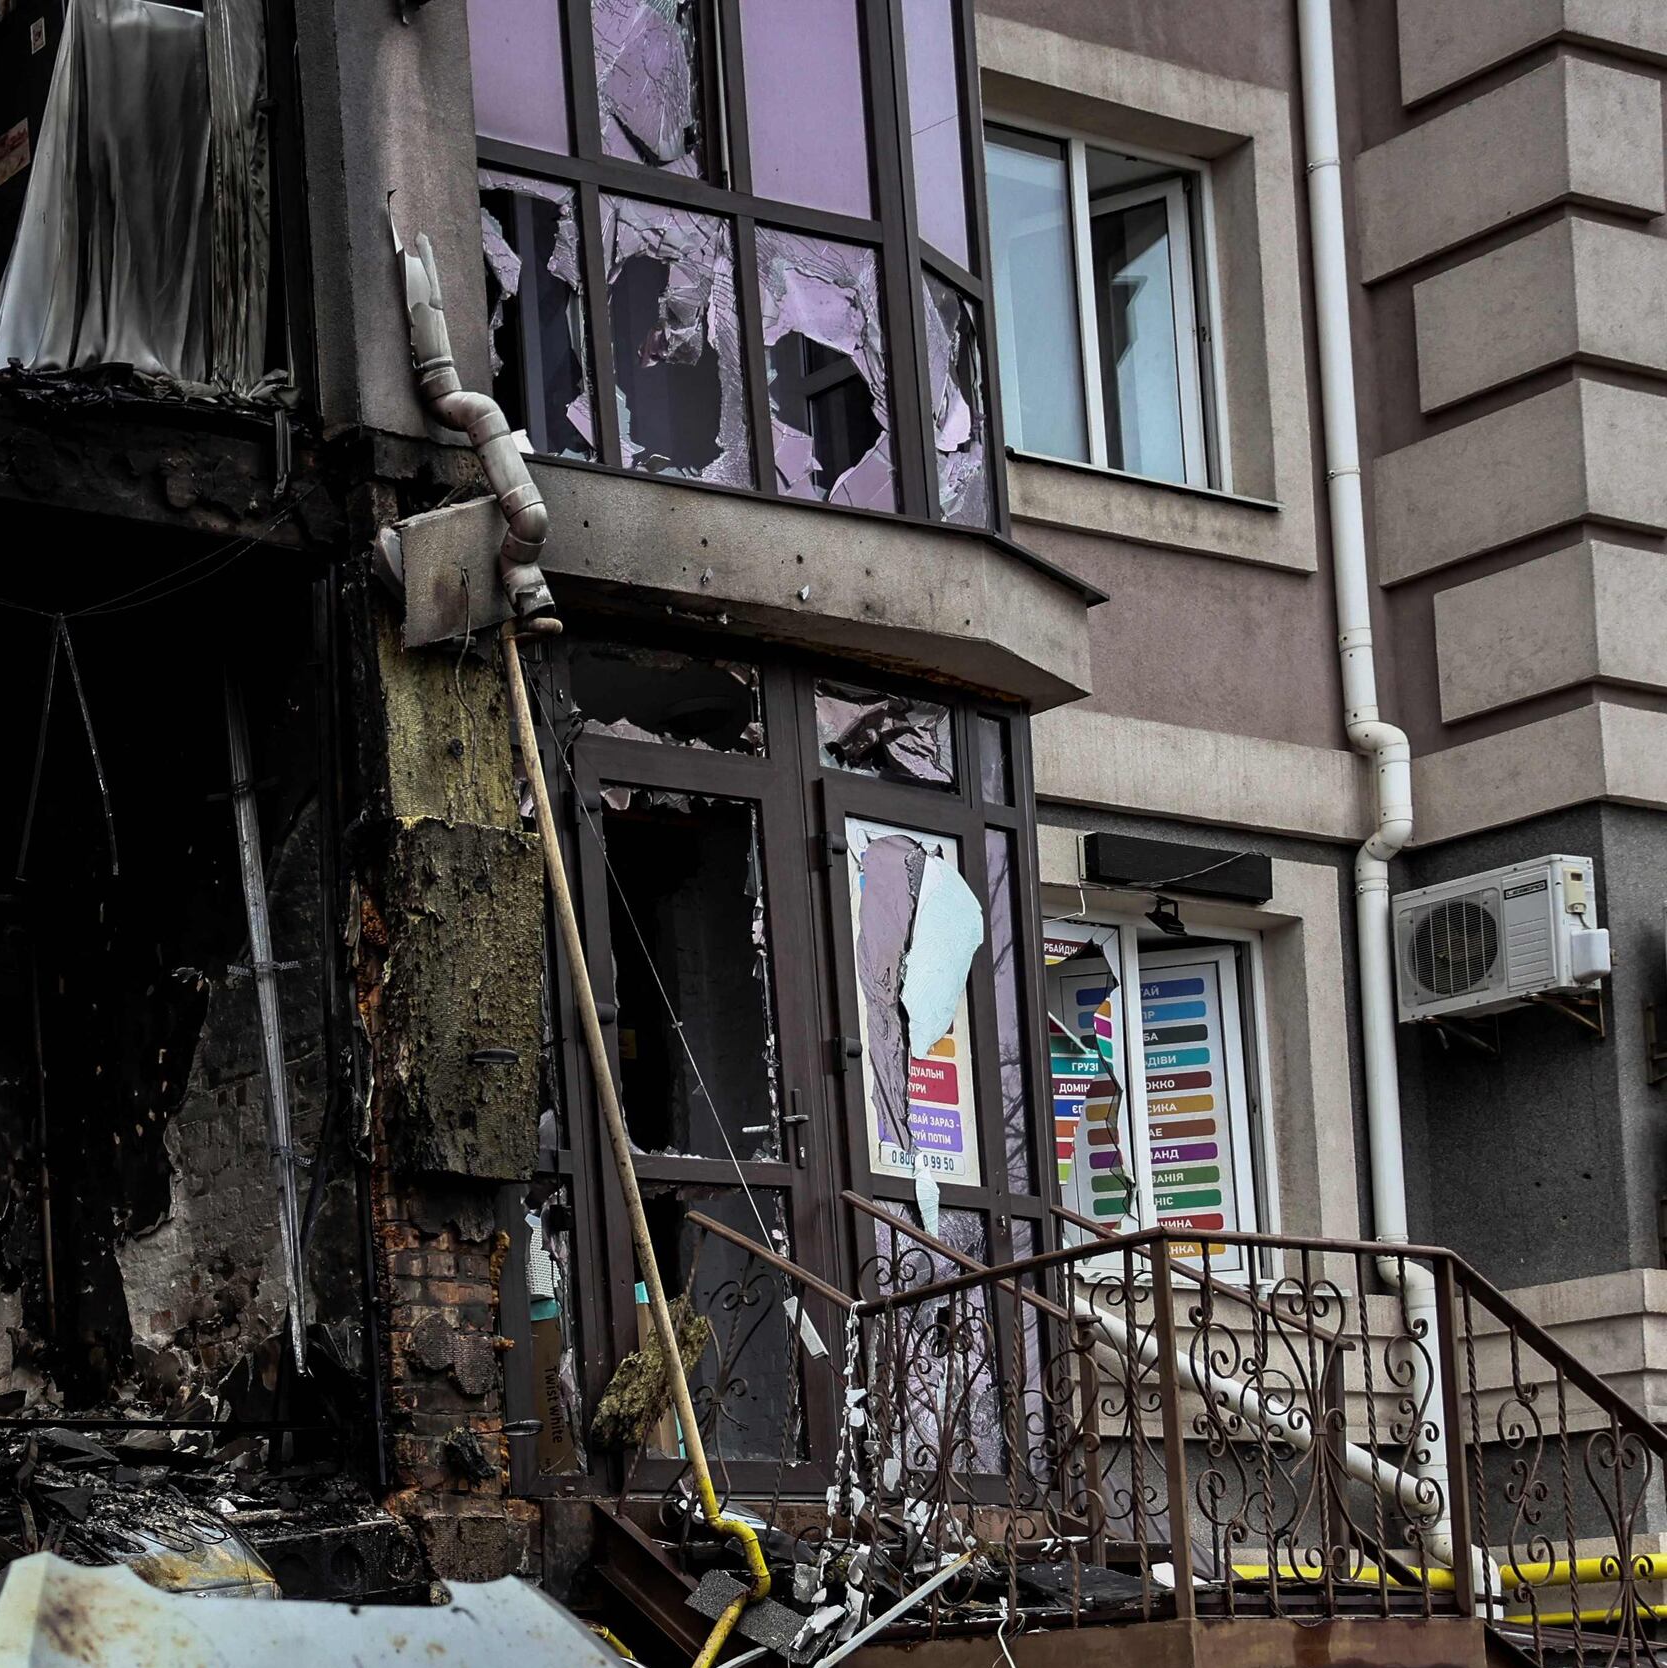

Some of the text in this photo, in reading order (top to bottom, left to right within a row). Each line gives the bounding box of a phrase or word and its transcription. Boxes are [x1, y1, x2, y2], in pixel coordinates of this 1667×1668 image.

[1141, 985, 1160, 997] АЙ
[1145, 1055, 1177, 1067] ДІВИ
[891, 1150, 897, 1164] 0
[931, 1155, 941, 1169] 99
[943, 1157, 954, 1171] 50
[1169, 1245, 1196, 1255] НКА
[544, 1365, 559, 1402] Twist
[549, 1405, 564, 1444] white
